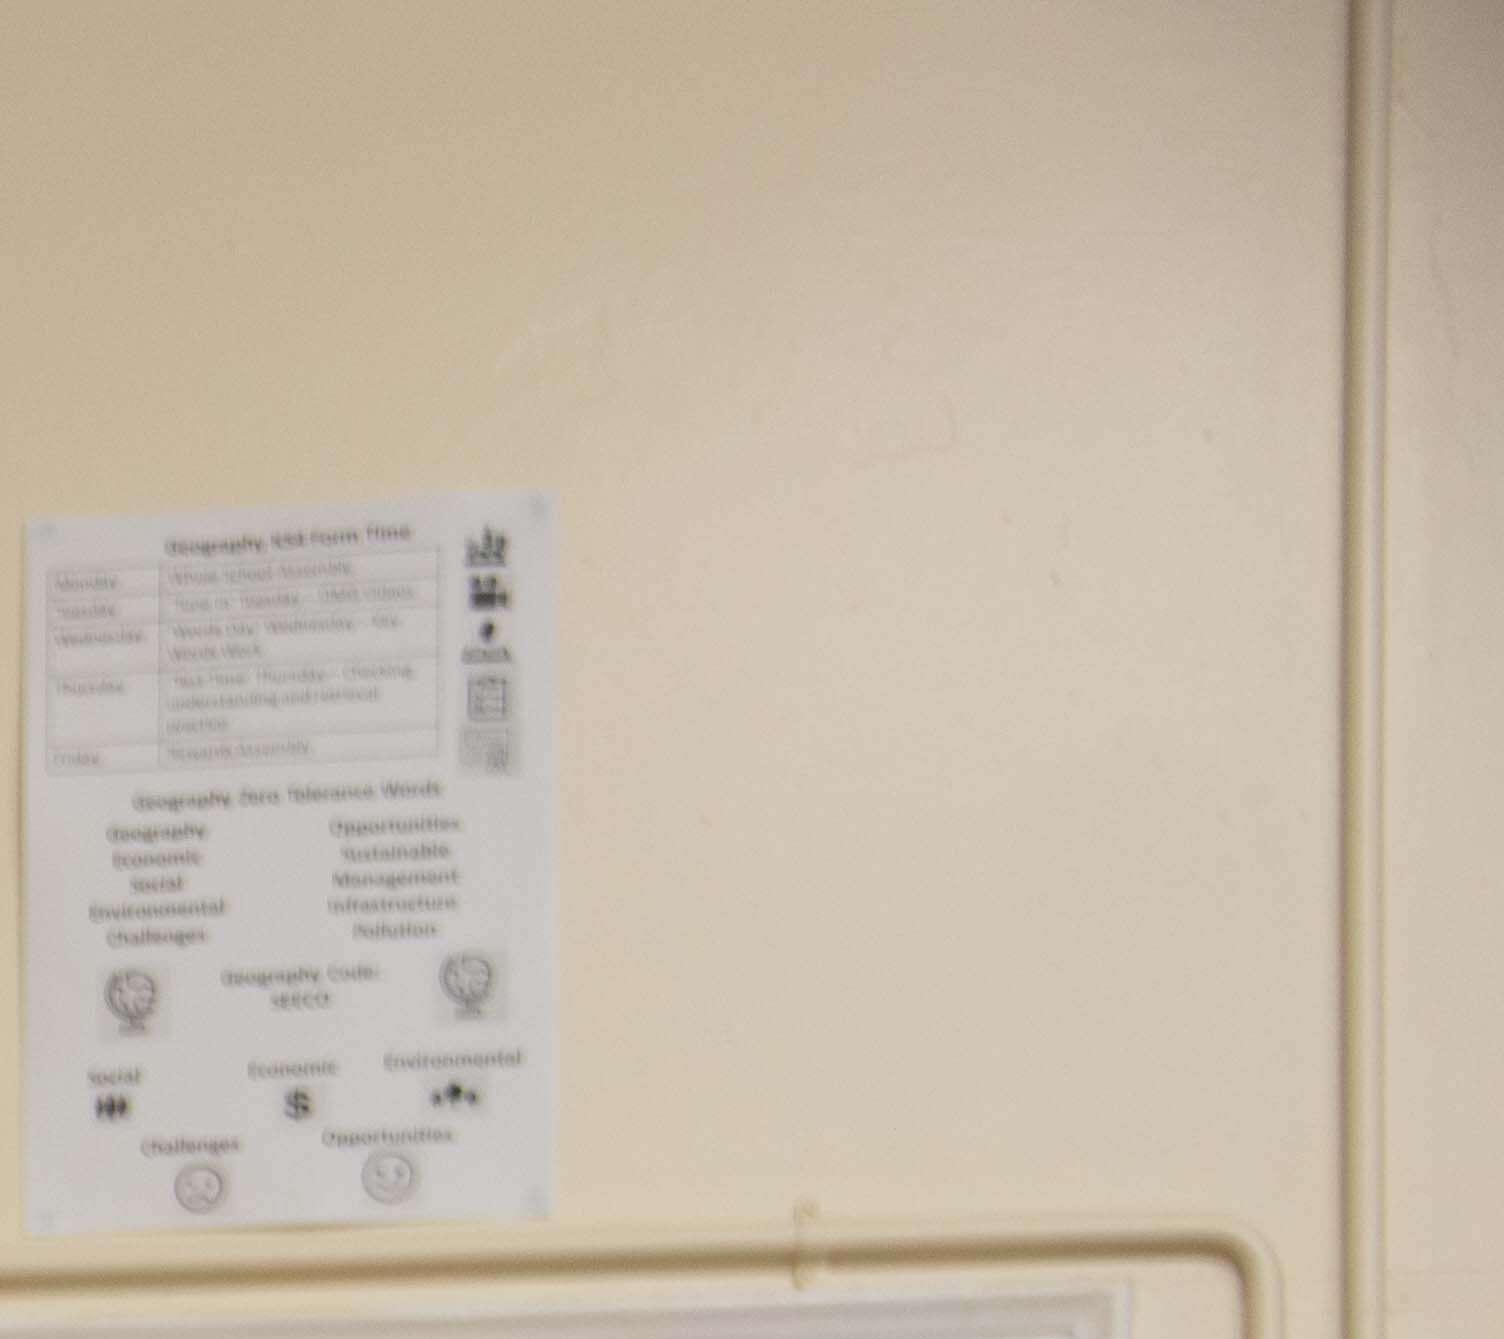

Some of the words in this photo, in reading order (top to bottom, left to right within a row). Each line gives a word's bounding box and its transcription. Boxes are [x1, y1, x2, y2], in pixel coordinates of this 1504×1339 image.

[380, 779, 443, 800] Words
[106, 823, 208, 845] Geography
[328, 815, 461, 837] Opportunities
[111, 849, 202, 869] Economic
[130, 875, 184, 894] Social
[331, 868, 459, 890] Management
[88, 898, 226, 922] Environmental
[327, 895, 458, 914] Infrastructure
[106, 926, 208, 948] Challenges
[383, 1049, 524, 1071] Environmental
[140, 1136, 240, 1158] Challenges
[321, 1127, 454, 1149] Opportunities
